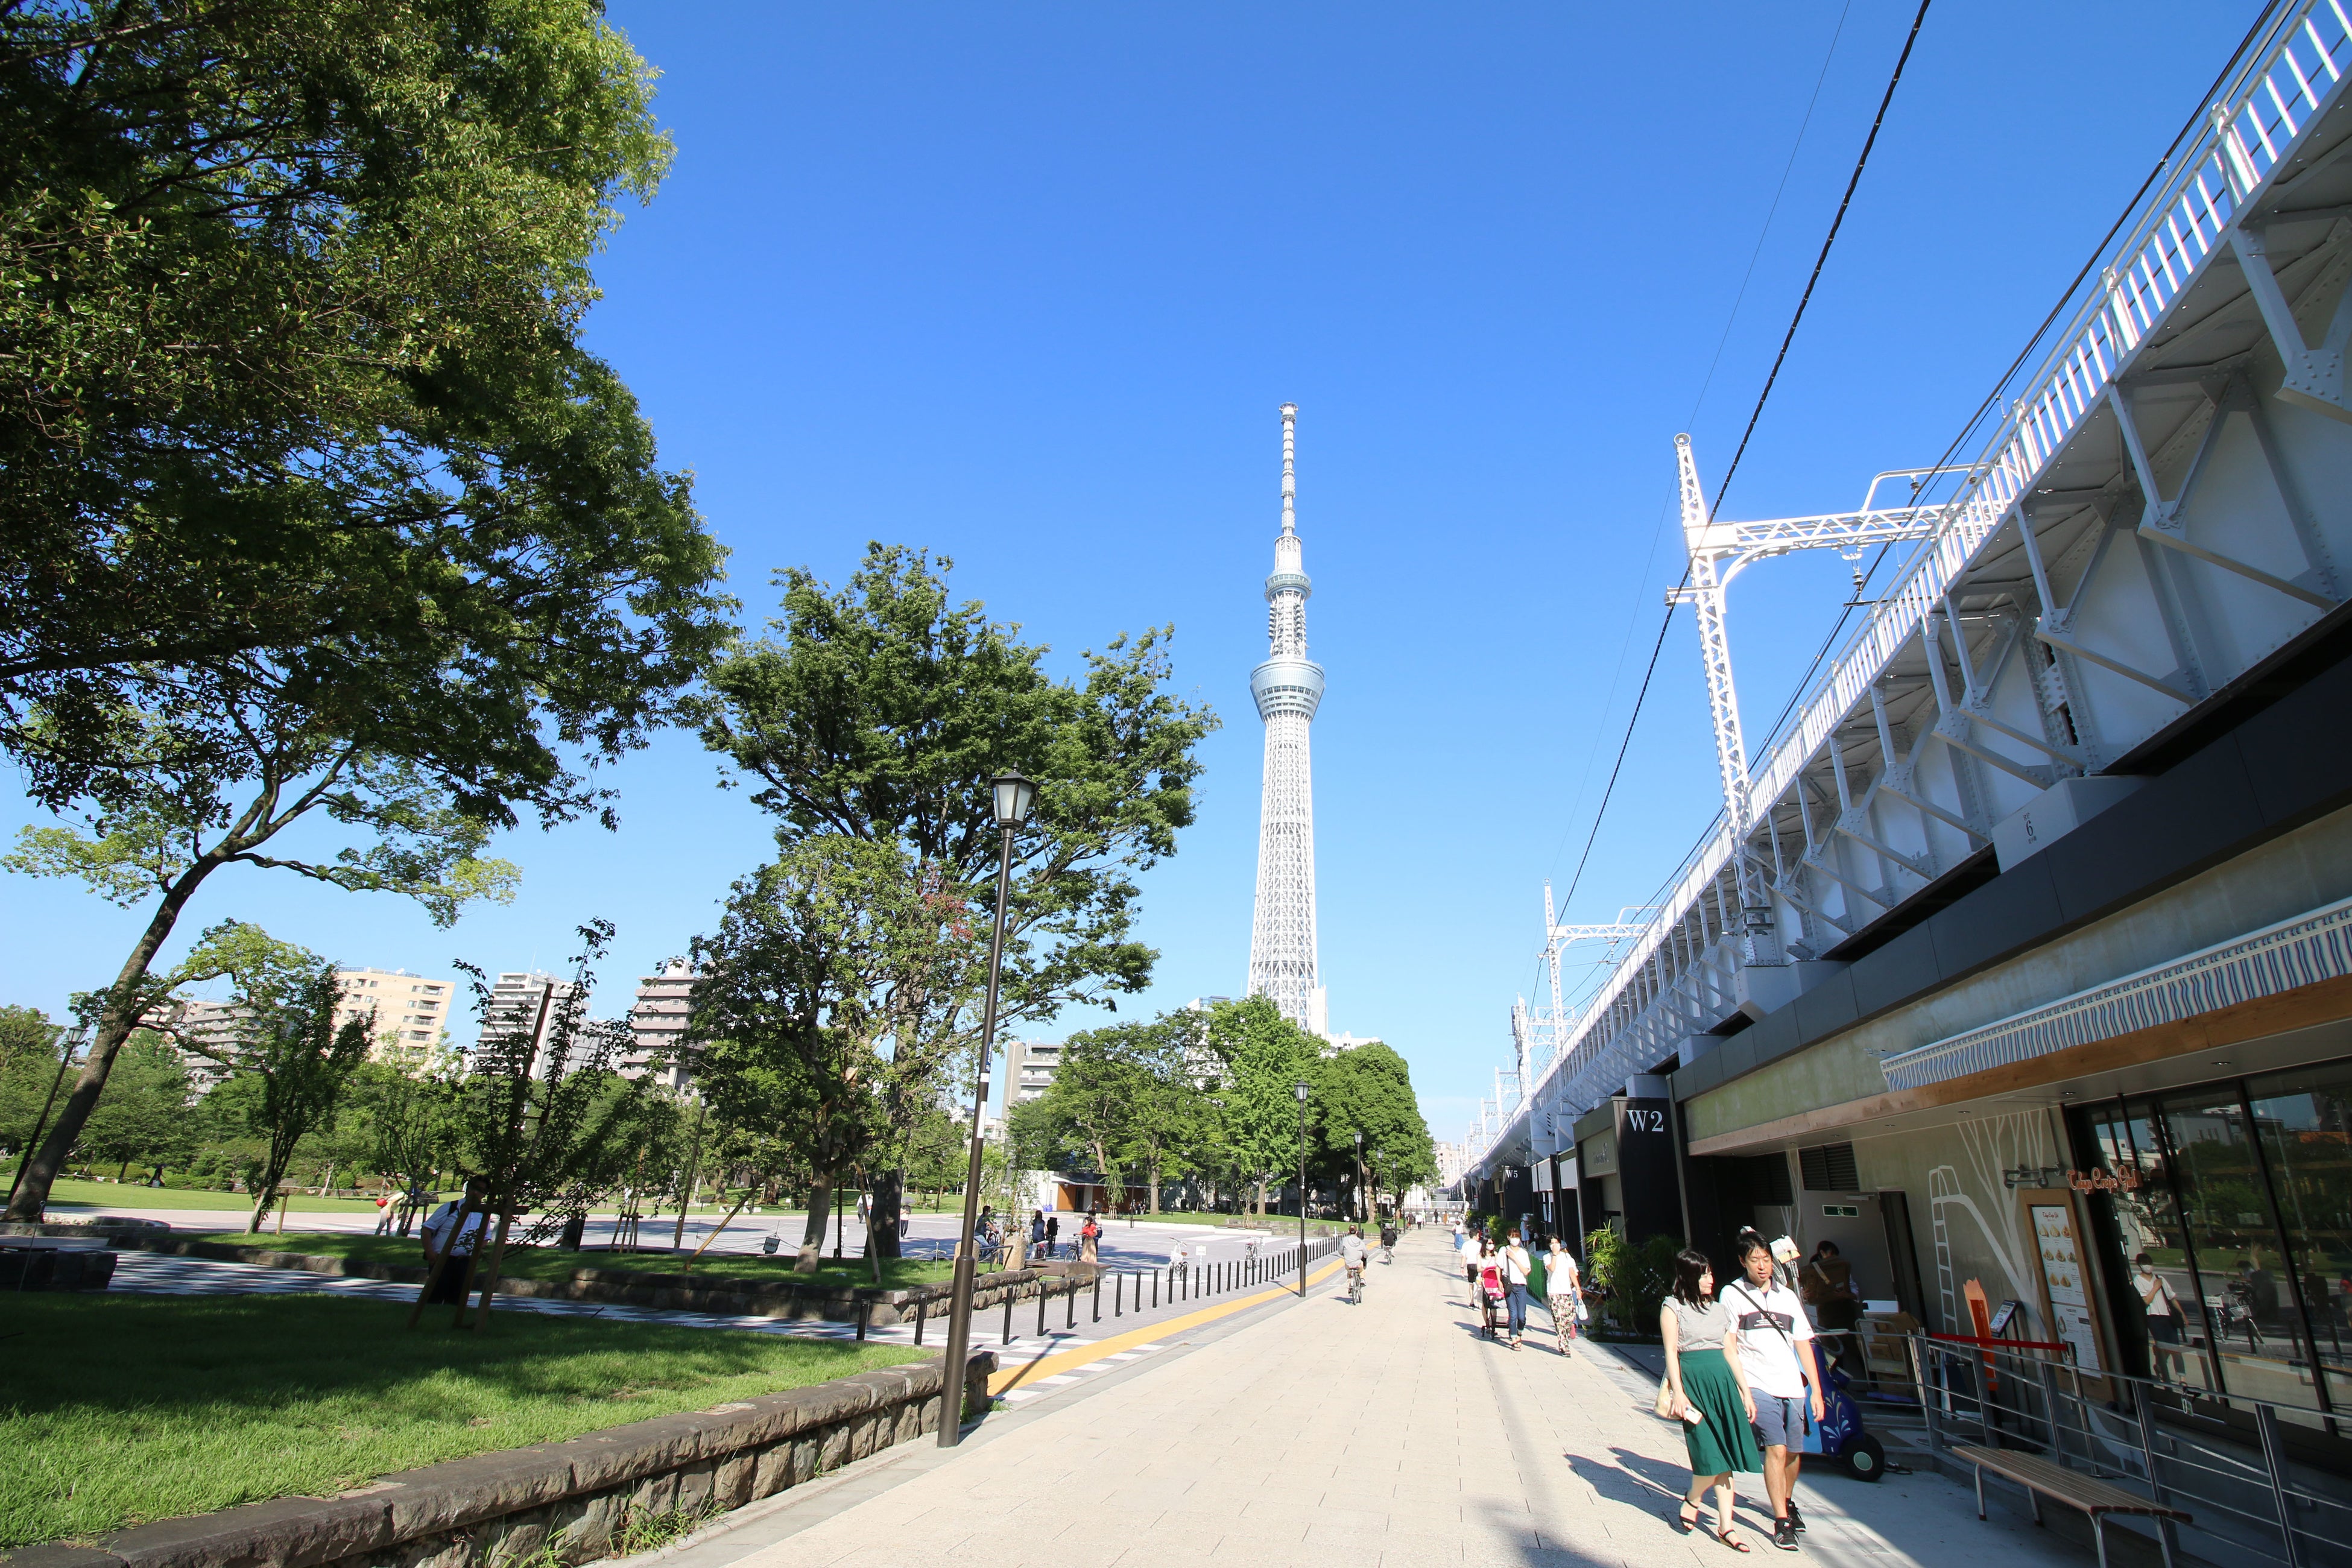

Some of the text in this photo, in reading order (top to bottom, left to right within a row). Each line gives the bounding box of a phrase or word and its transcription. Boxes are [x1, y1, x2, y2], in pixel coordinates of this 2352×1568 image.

[2026, 820, 2034, 836] 6
[1626, 1110, 1664, 1132] W2
[1505, 1169, 1518, 1178] W5
[2116, 1164, 2138, 1193] Girl
